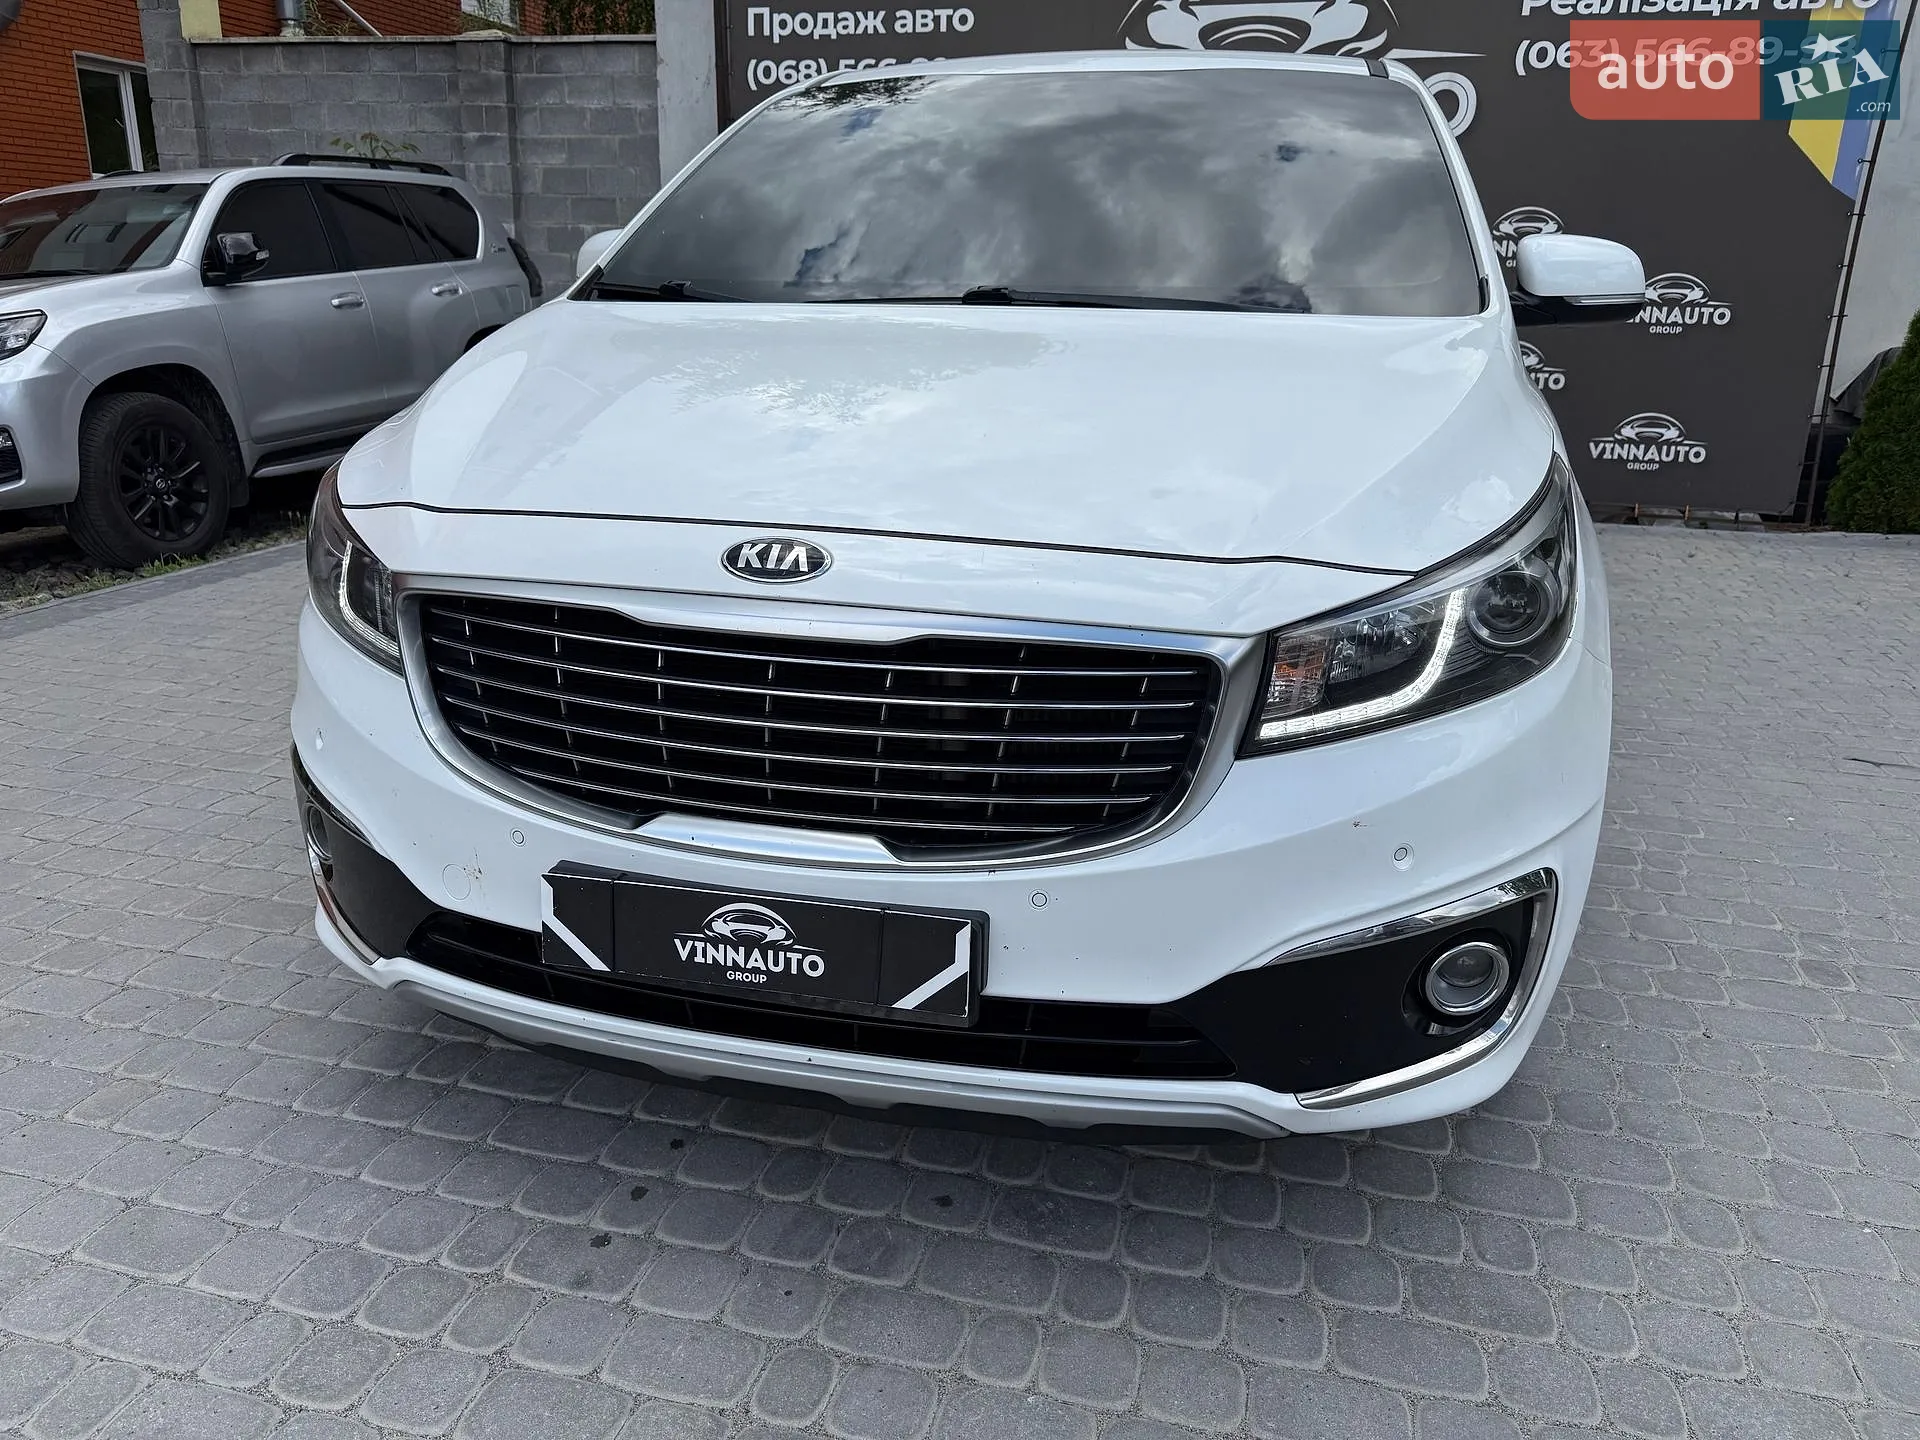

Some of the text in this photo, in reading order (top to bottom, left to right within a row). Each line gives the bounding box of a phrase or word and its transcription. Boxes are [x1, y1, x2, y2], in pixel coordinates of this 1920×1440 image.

[747, 7, 975, 43] Продаж авто
[1649, 325, 1683, 335] GROUP
[1588, 441, 1707, 464] VINNAUTO
[1626, 461, 1660, 471] GROUP
[737, 543, 809, 573] KIA
[673, 938, 826, 978] VINNAUTO
[726, 970, 768, 985] GROUP
